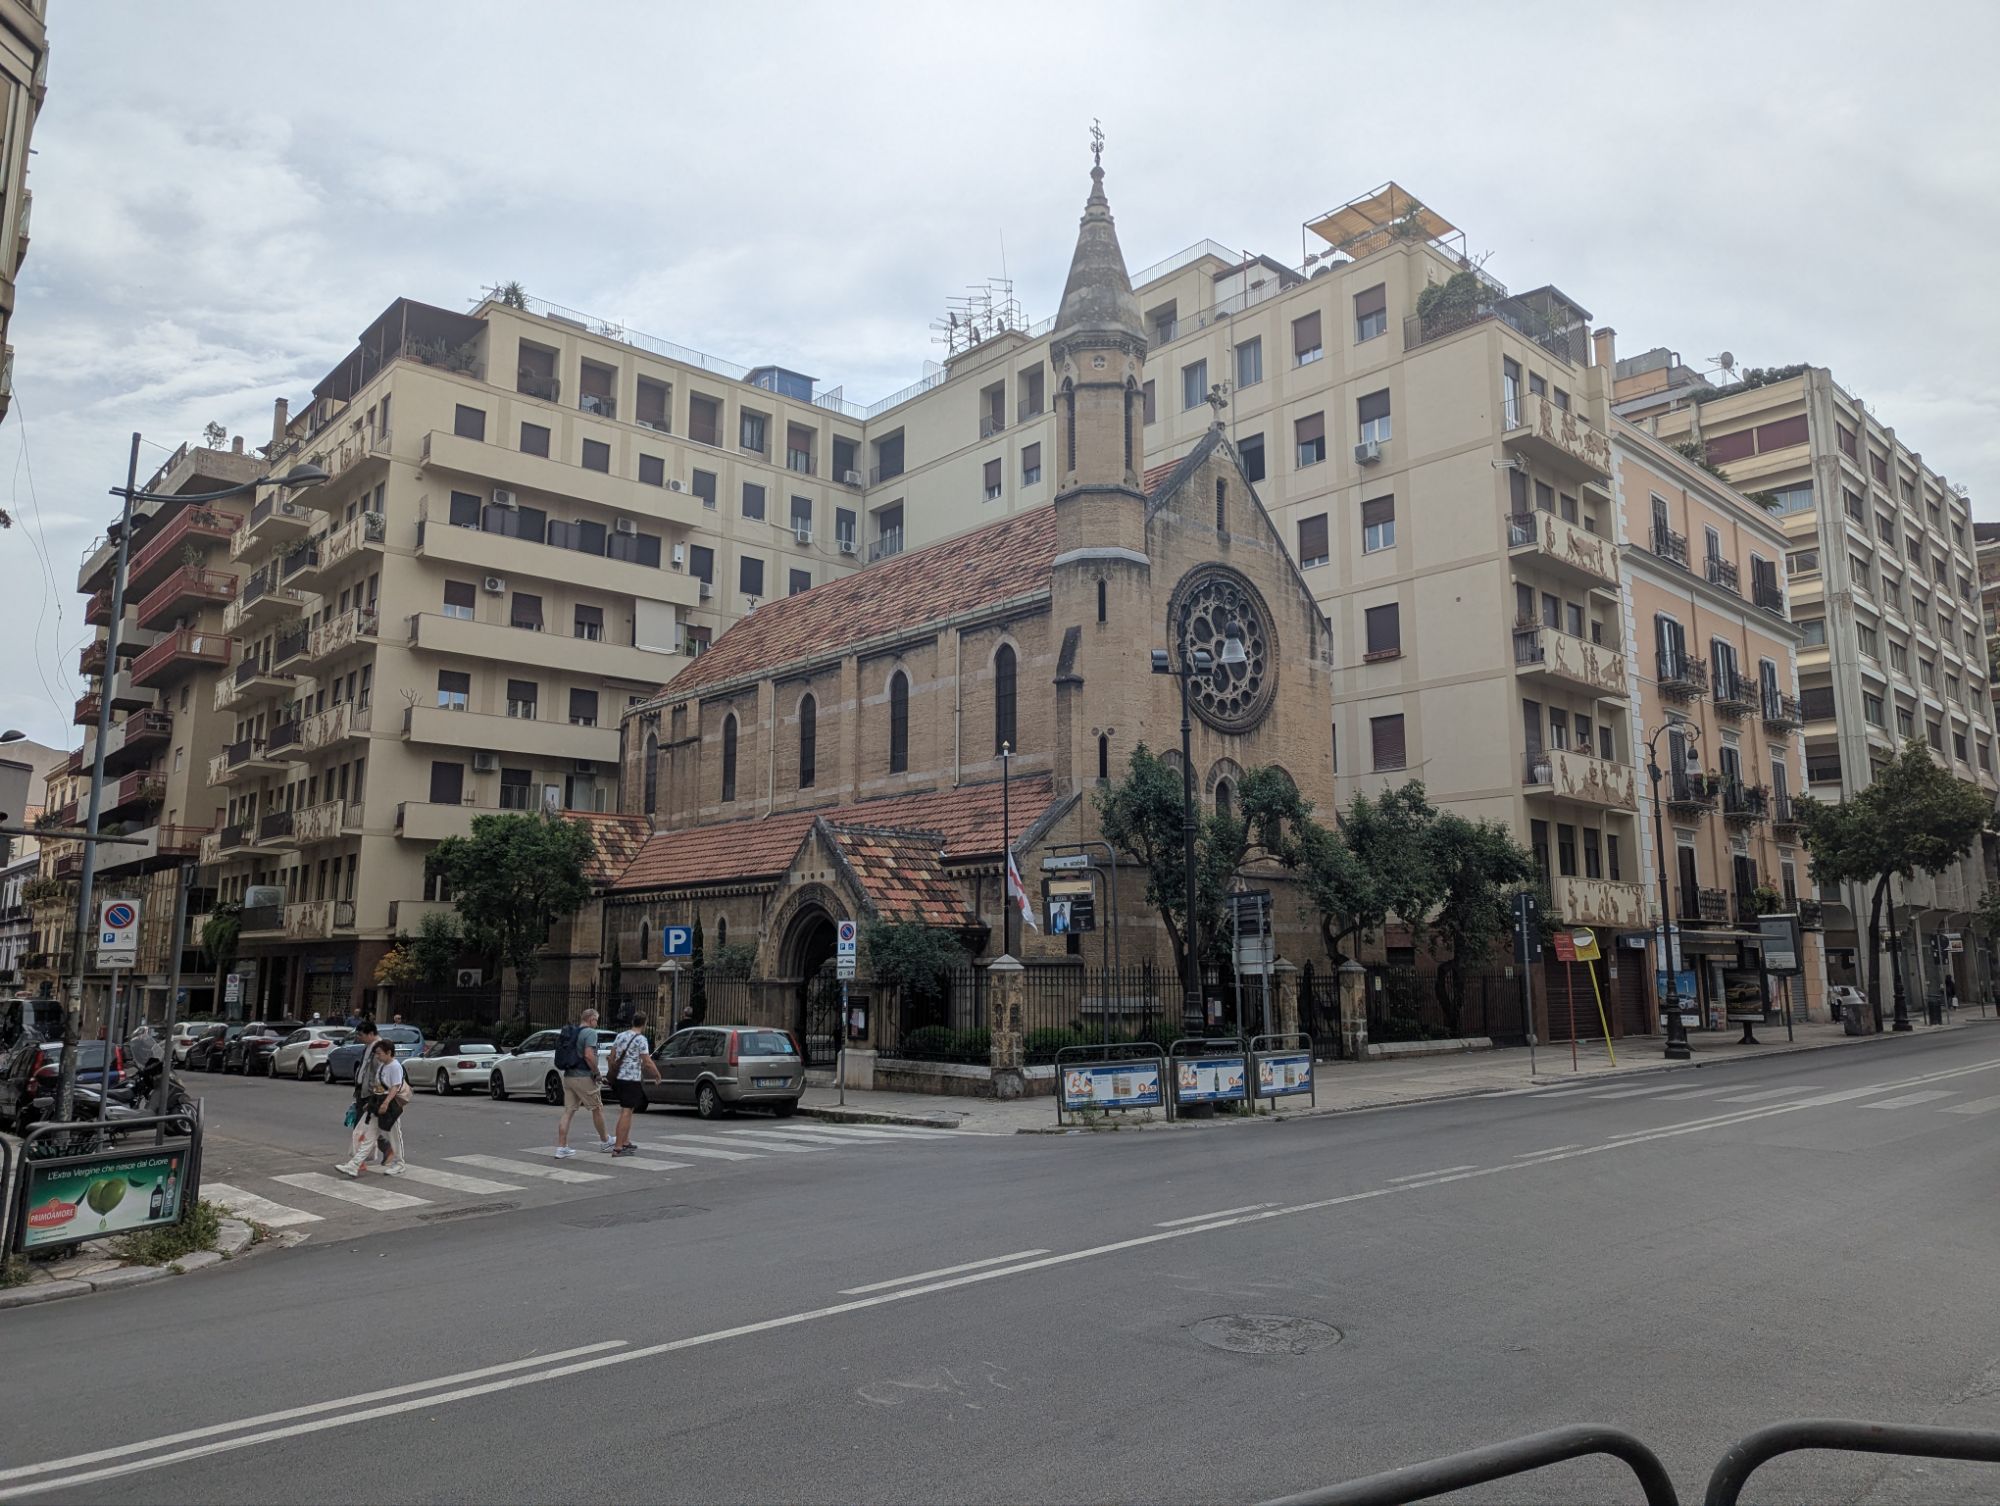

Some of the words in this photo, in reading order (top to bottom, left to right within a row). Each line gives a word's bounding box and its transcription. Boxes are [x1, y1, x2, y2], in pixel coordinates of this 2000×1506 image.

[105, 934, 113, 942] P
[669, 929, 687, 953] P
[47, 1171, 72, 1181] L'Extra
[73, 1167, 100, 1177] Vergine
[101, 1165, 115, 1173] che
[116, 1163, 136, 1171] nasce
[136, 1160, 147, 1168] dal
[148, 1158, 169, 1167] Cuore
[30, 1208, 75, 1223] PRIMOAMORE
